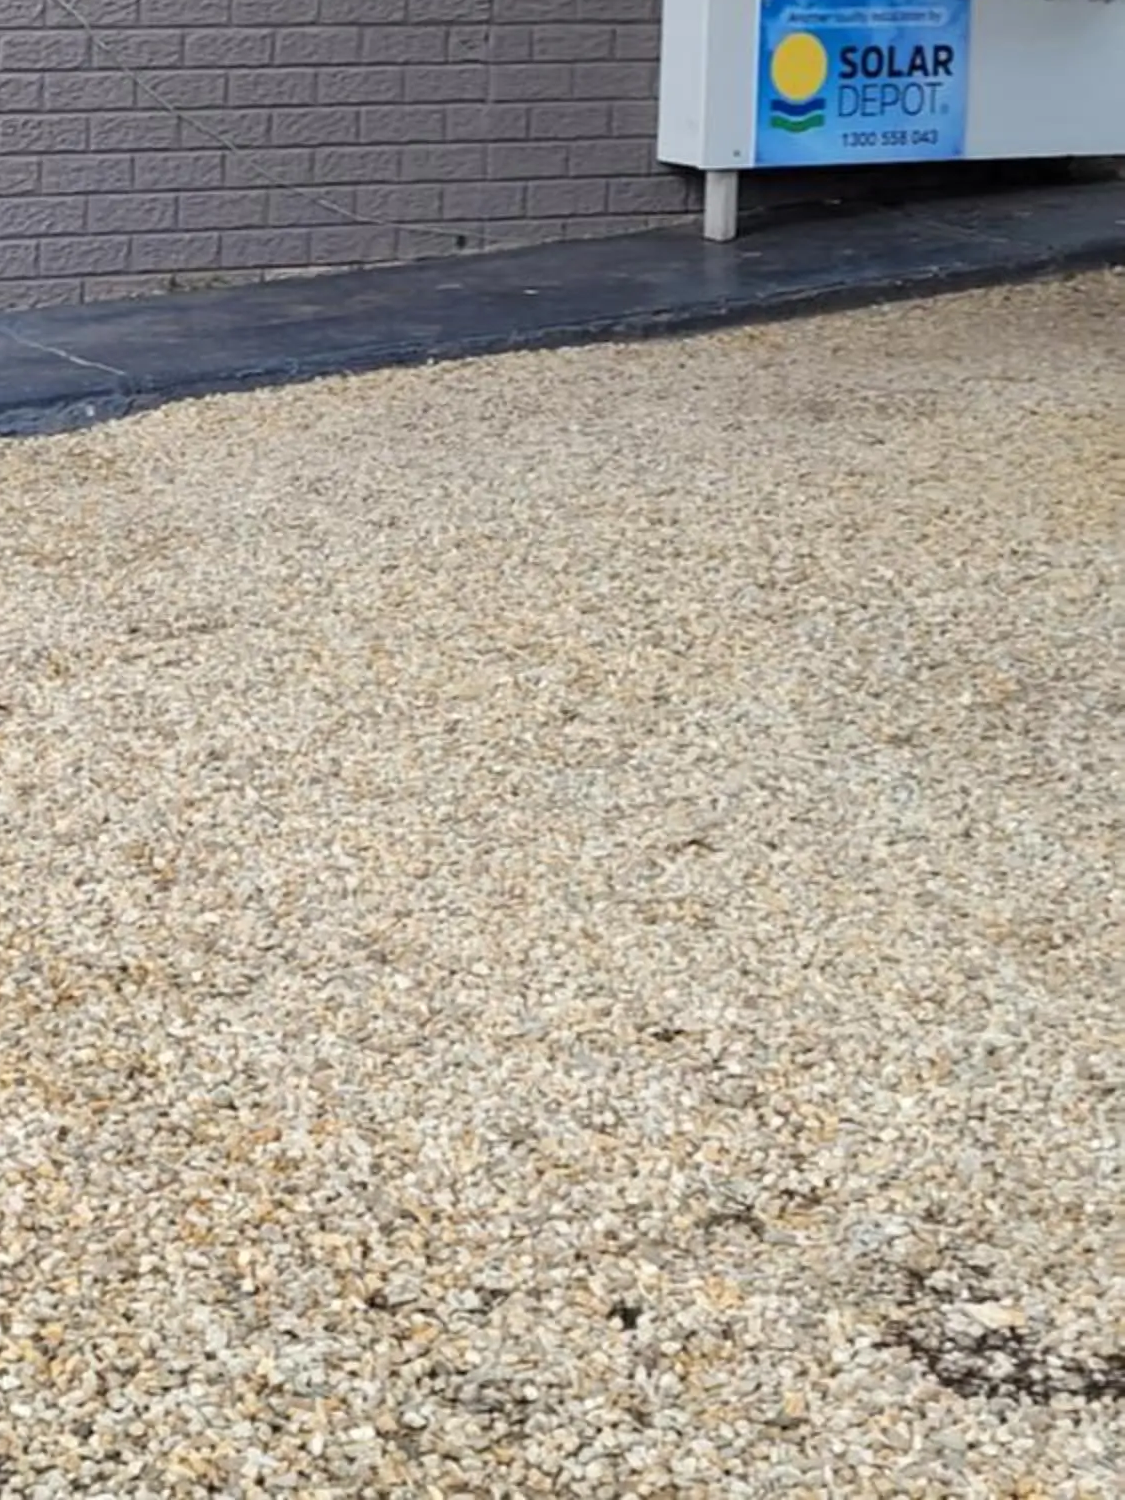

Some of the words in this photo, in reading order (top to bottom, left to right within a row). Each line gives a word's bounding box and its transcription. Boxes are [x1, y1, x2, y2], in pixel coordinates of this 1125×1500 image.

[838, 44, 955, 80] SOLAR
[837, 82, 943, 118] DEPOT
[842, 131, 876, 148] 1300
